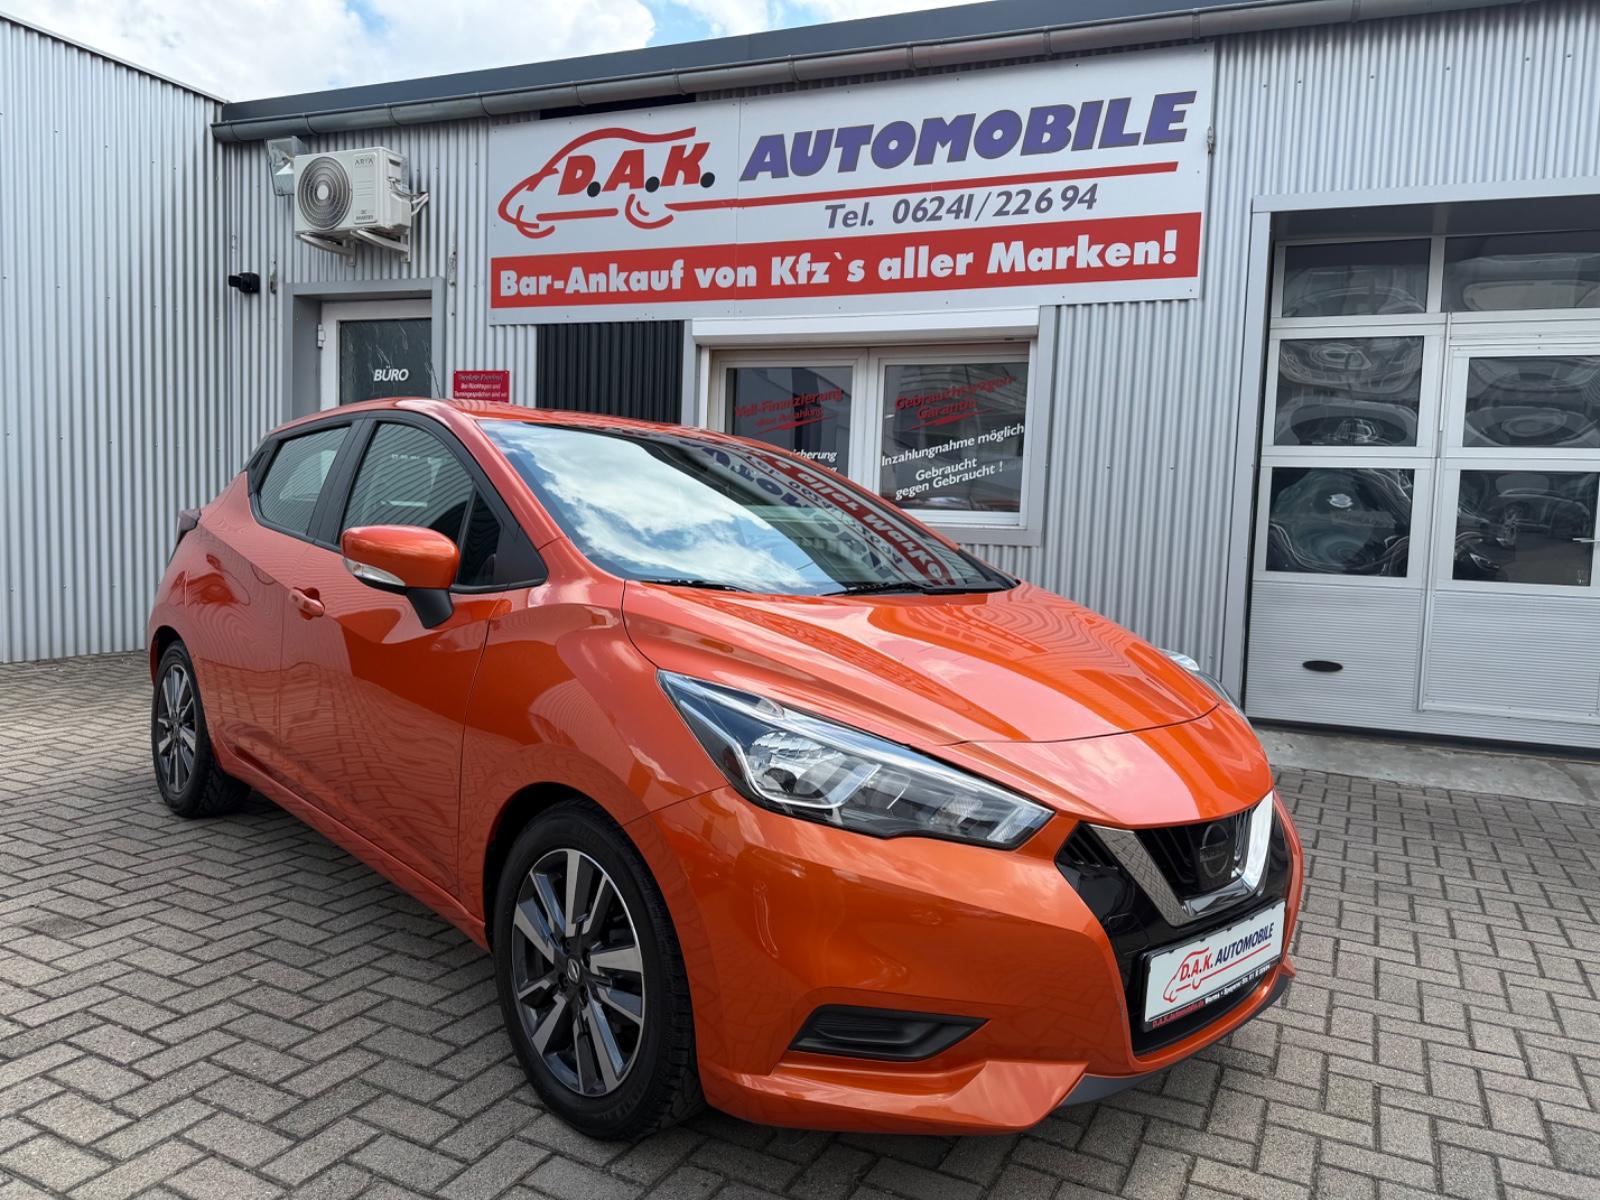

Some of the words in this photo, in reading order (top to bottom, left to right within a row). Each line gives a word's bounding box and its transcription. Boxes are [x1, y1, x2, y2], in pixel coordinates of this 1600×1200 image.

[558, 142, 716, 198] D.A.K.
[739, 90, 1198, 182] AUTOMOBILE
[825, 203, 874, 229] Tel.
[500, 259, 684, 297] Bar-Ankauf
[694, 265, 757, 289] von
[878, 245, 973, 281] aller
[987, 229, 1178, 274] Marken!
[373, 366, 409, 382] BÜRO
[881, 440, 975, 466] Inzahlungnahme
[977, 423, 1025, 445] möglich
[895, 482, 930, 500] gegen
[932, 464, 996, 488] Gebraucht
[915, 457, 978, 481] Gebraucht
[1180, 953, 1213, 982] D.A.K.
[1214, 922, 1275, 967] AUTOMOBILE
